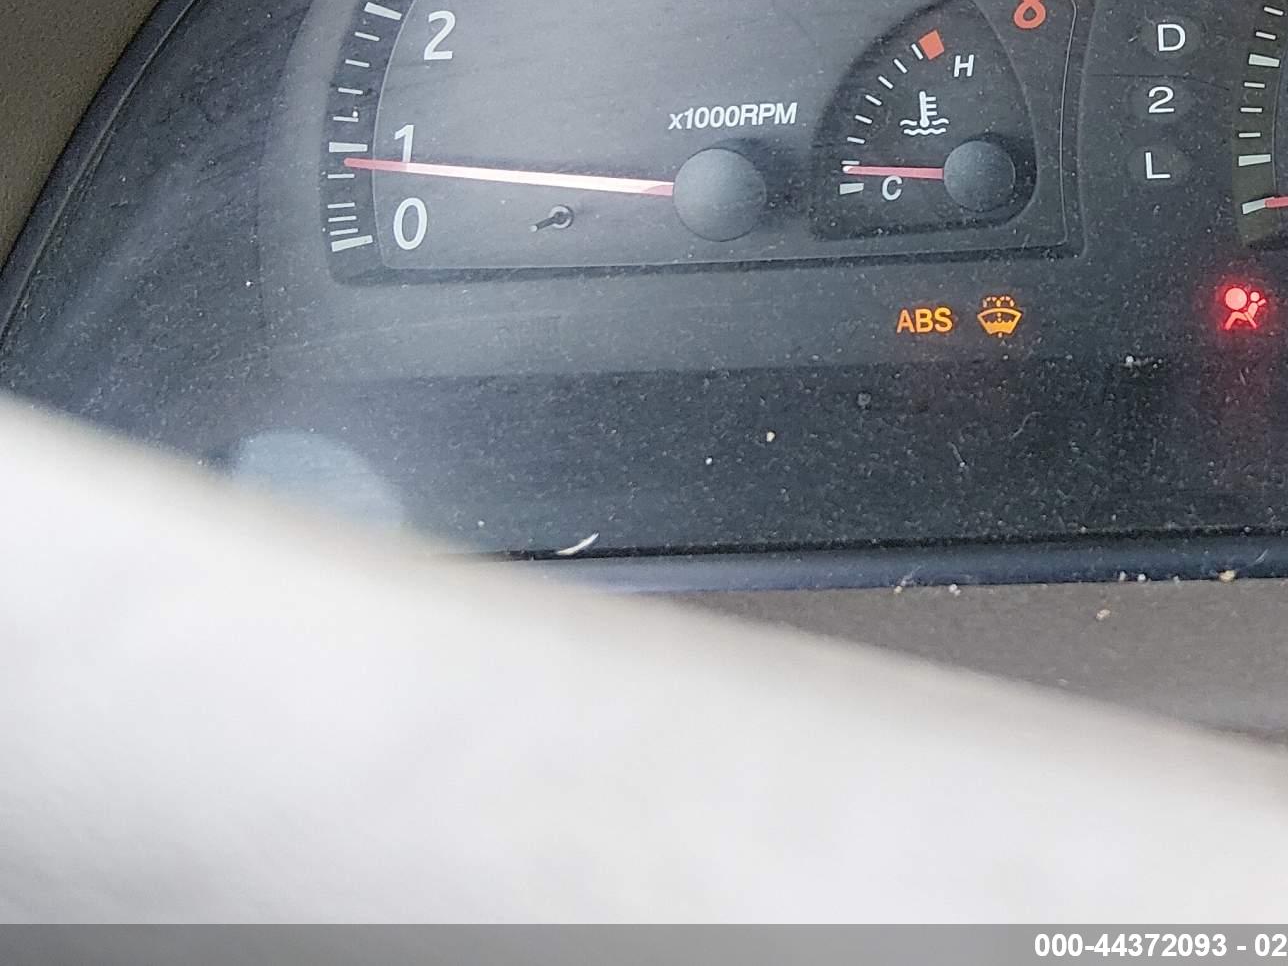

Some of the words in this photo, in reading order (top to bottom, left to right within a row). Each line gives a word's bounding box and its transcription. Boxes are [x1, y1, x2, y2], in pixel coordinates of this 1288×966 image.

[424, 11, 455, 60] 2
[1158, 24, 1185, 51] D
[954, 55, 974, 77] H
[1149, 87, 1174, 113] 2
[668, 103, 797, 129] x1000RPM
[394, 124, 415, 164] 1
[1146, 153, 1170, 178] L
[881, 176, 903, 201] C
[393, 198, 427, 249] 0
[897, 308, 952, 332] ABS
